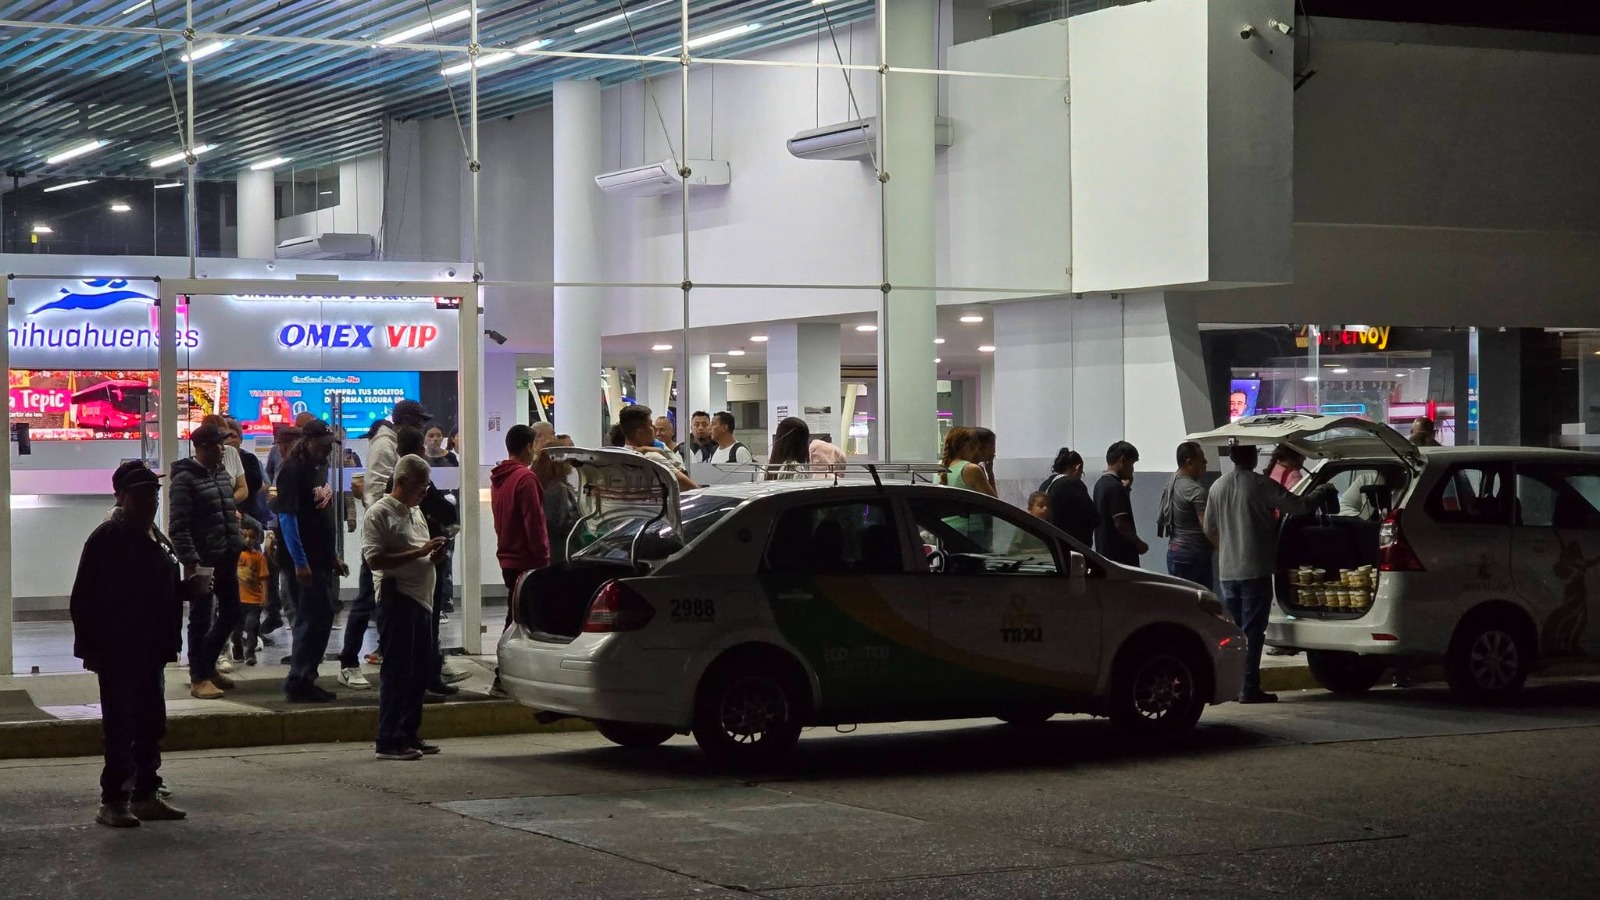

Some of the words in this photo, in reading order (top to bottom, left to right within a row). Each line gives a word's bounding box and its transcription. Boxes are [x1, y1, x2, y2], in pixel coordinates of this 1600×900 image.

[279, 324, 374, 347] OMEX
[387, 325, 438, 348] VIP
[20, 390, 65, 412] Tepic
[669, 598, 715, 617] 2988
[1000, 627, 1043, 643] TAXI
